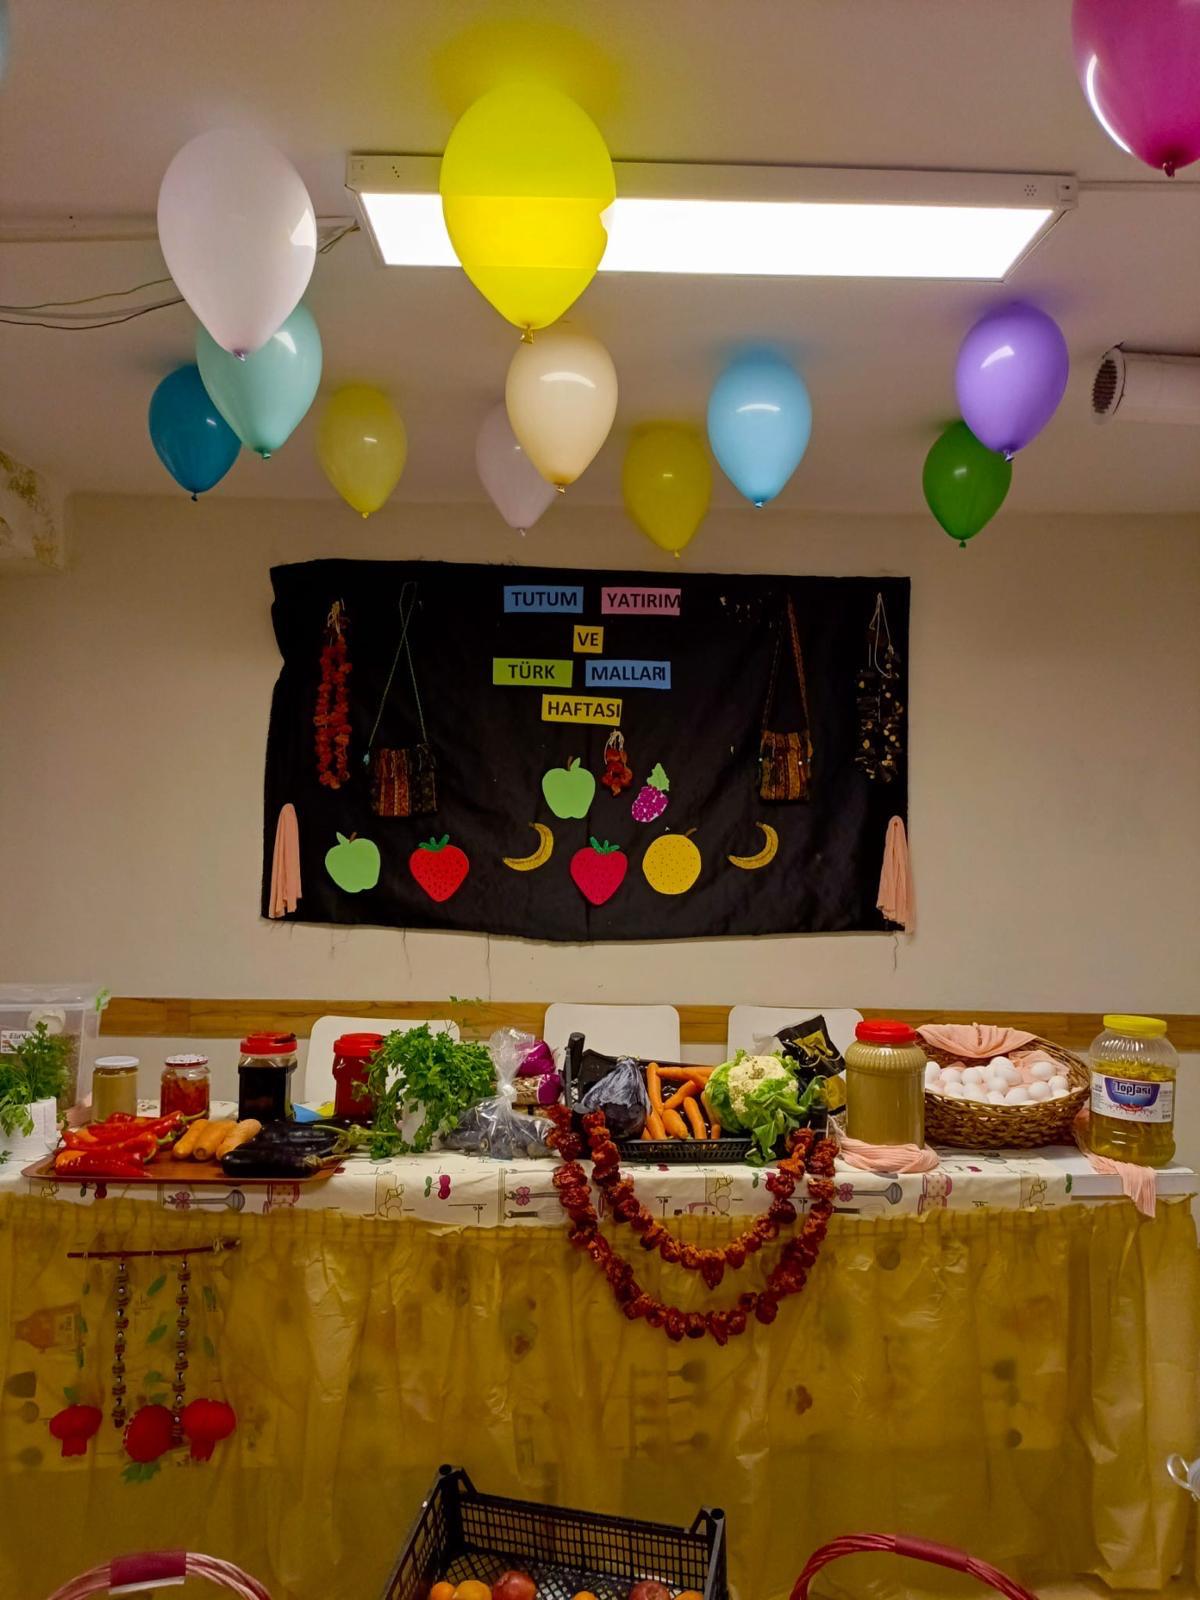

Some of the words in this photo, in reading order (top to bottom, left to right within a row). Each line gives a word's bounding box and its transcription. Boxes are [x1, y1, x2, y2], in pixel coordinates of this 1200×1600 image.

[511, 591, 578, 607] TUTUM
[607, 592, 681, 609] YATIRIM
[577, 631, 600, 647] VE
[508, 661, 556, 680] TÜRK
[591, 666, 666, 681] MALLARI
[547, 701, 621, 719] HAFTASI
